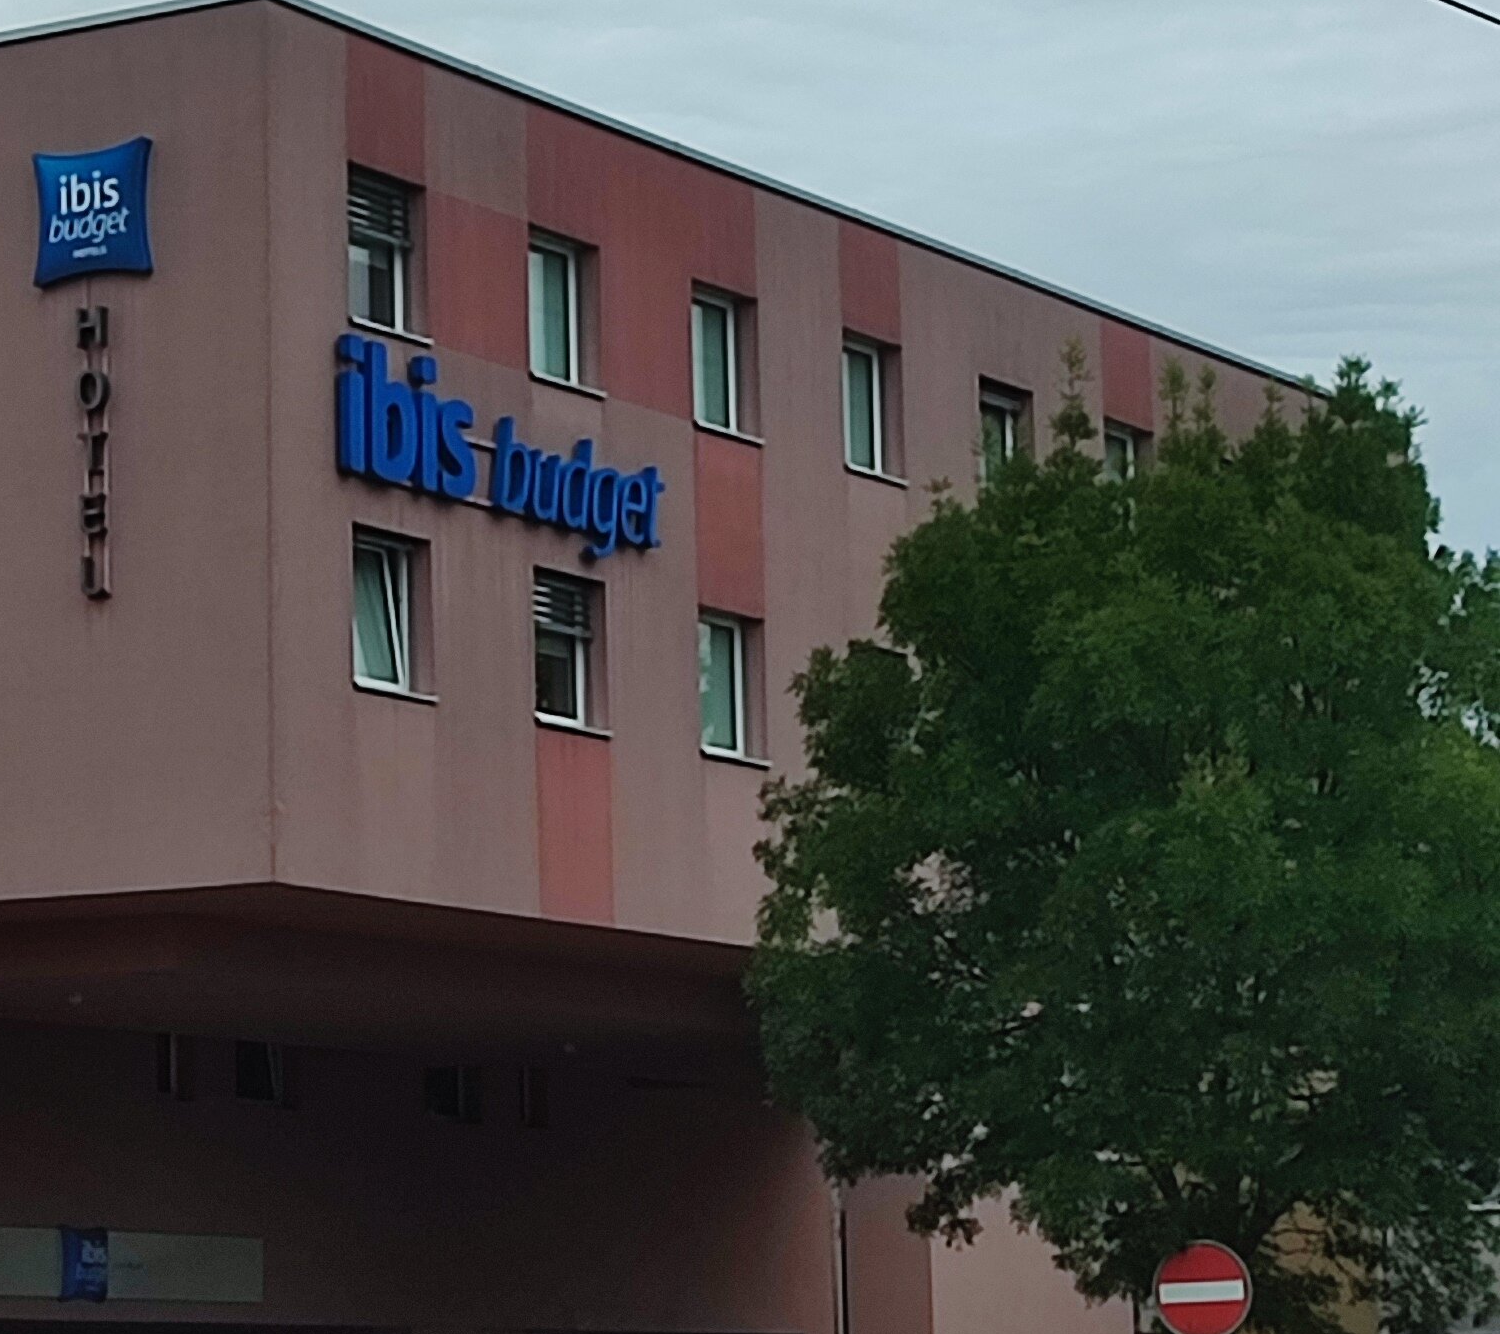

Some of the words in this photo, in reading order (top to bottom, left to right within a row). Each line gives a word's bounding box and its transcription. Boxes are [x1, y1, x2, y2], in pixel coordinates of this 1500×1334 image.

[49, 206, 130, 243] budget
[59, 170, 119, 215] ibis
[75, 305, 111, 599] HOTEL
[336, 334, 476, 499] ibis
[490, 416, 666, 560] budget
